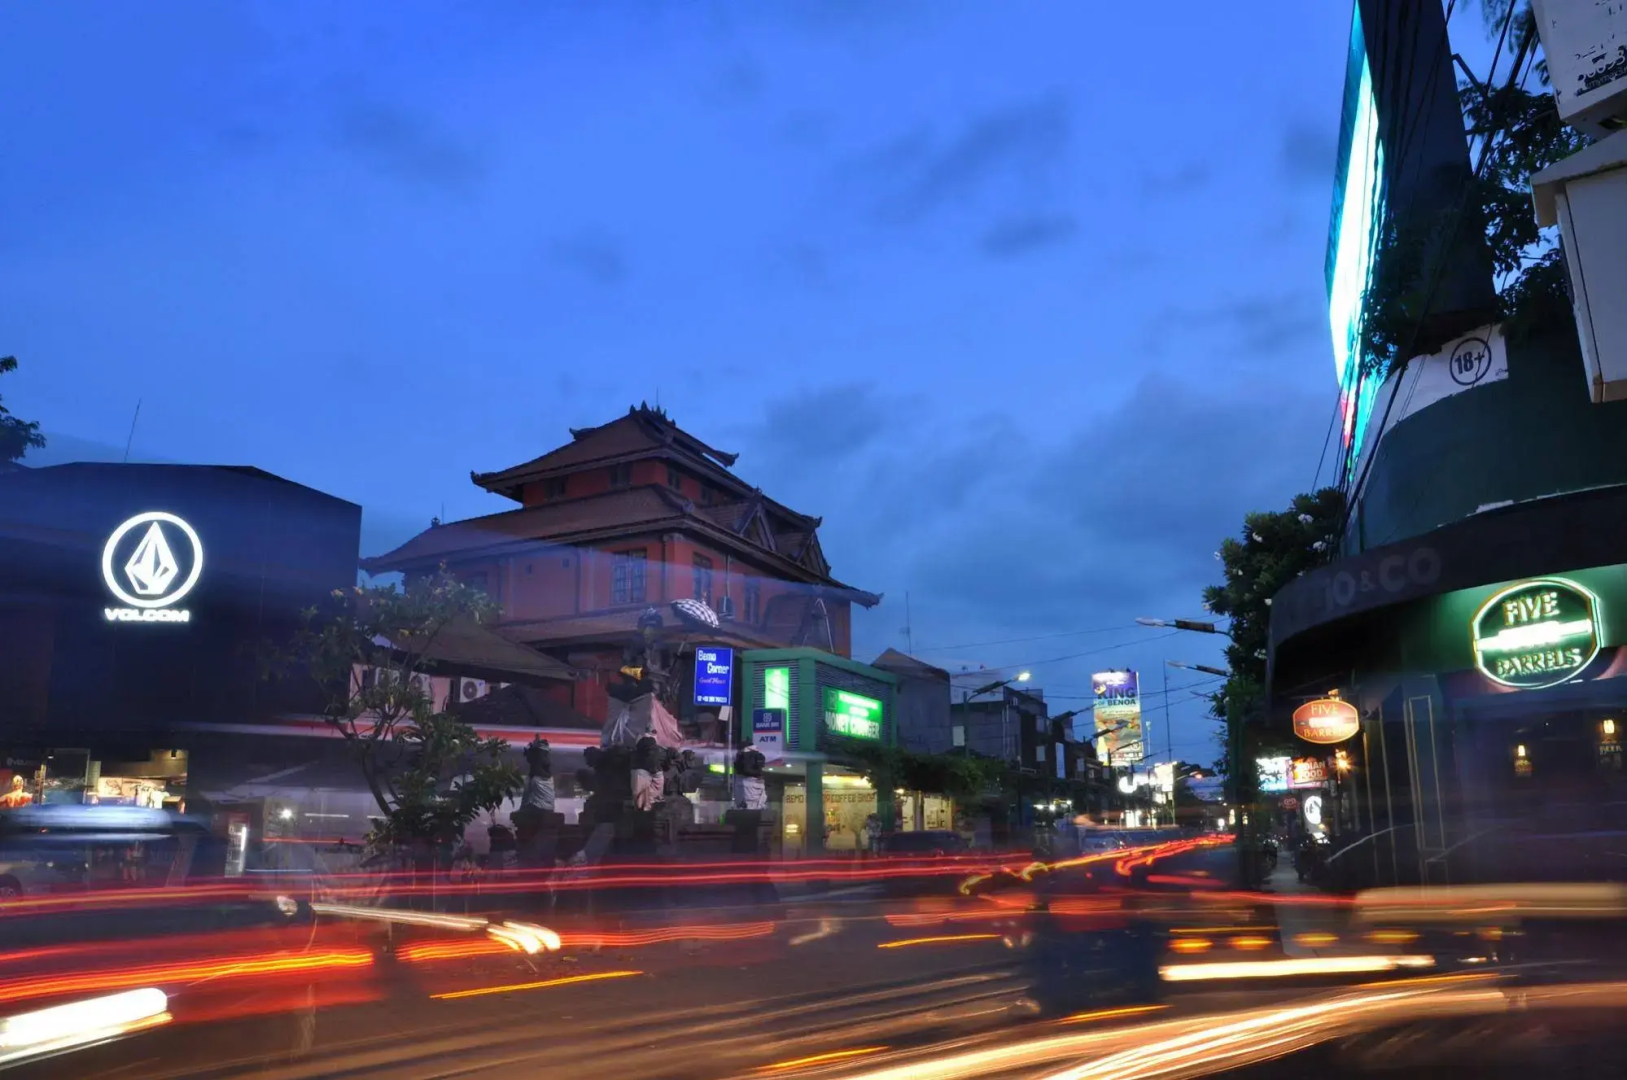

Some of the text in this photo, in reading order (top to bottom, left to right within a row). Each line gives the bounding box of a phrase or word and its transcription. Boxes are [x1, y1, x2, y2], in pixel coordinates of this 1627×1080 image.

[1454, 351, 1485, 375] 18+
[1502, 590, 1561, 626] FIVE
[104, 607, 190, 623] VOLCOM
[1495, 648, 1584, 680] BARRELS
[1107, 699, 1137, 707] BENOA
[1311, 703, 1339, 716] FIVE
[759, 735, 777, 743] ATM
[1303, 728, 1352, 738] BARRL
[786, 794, 804, 803] BEMO
[830, 793, 856, 803] COFFEE
